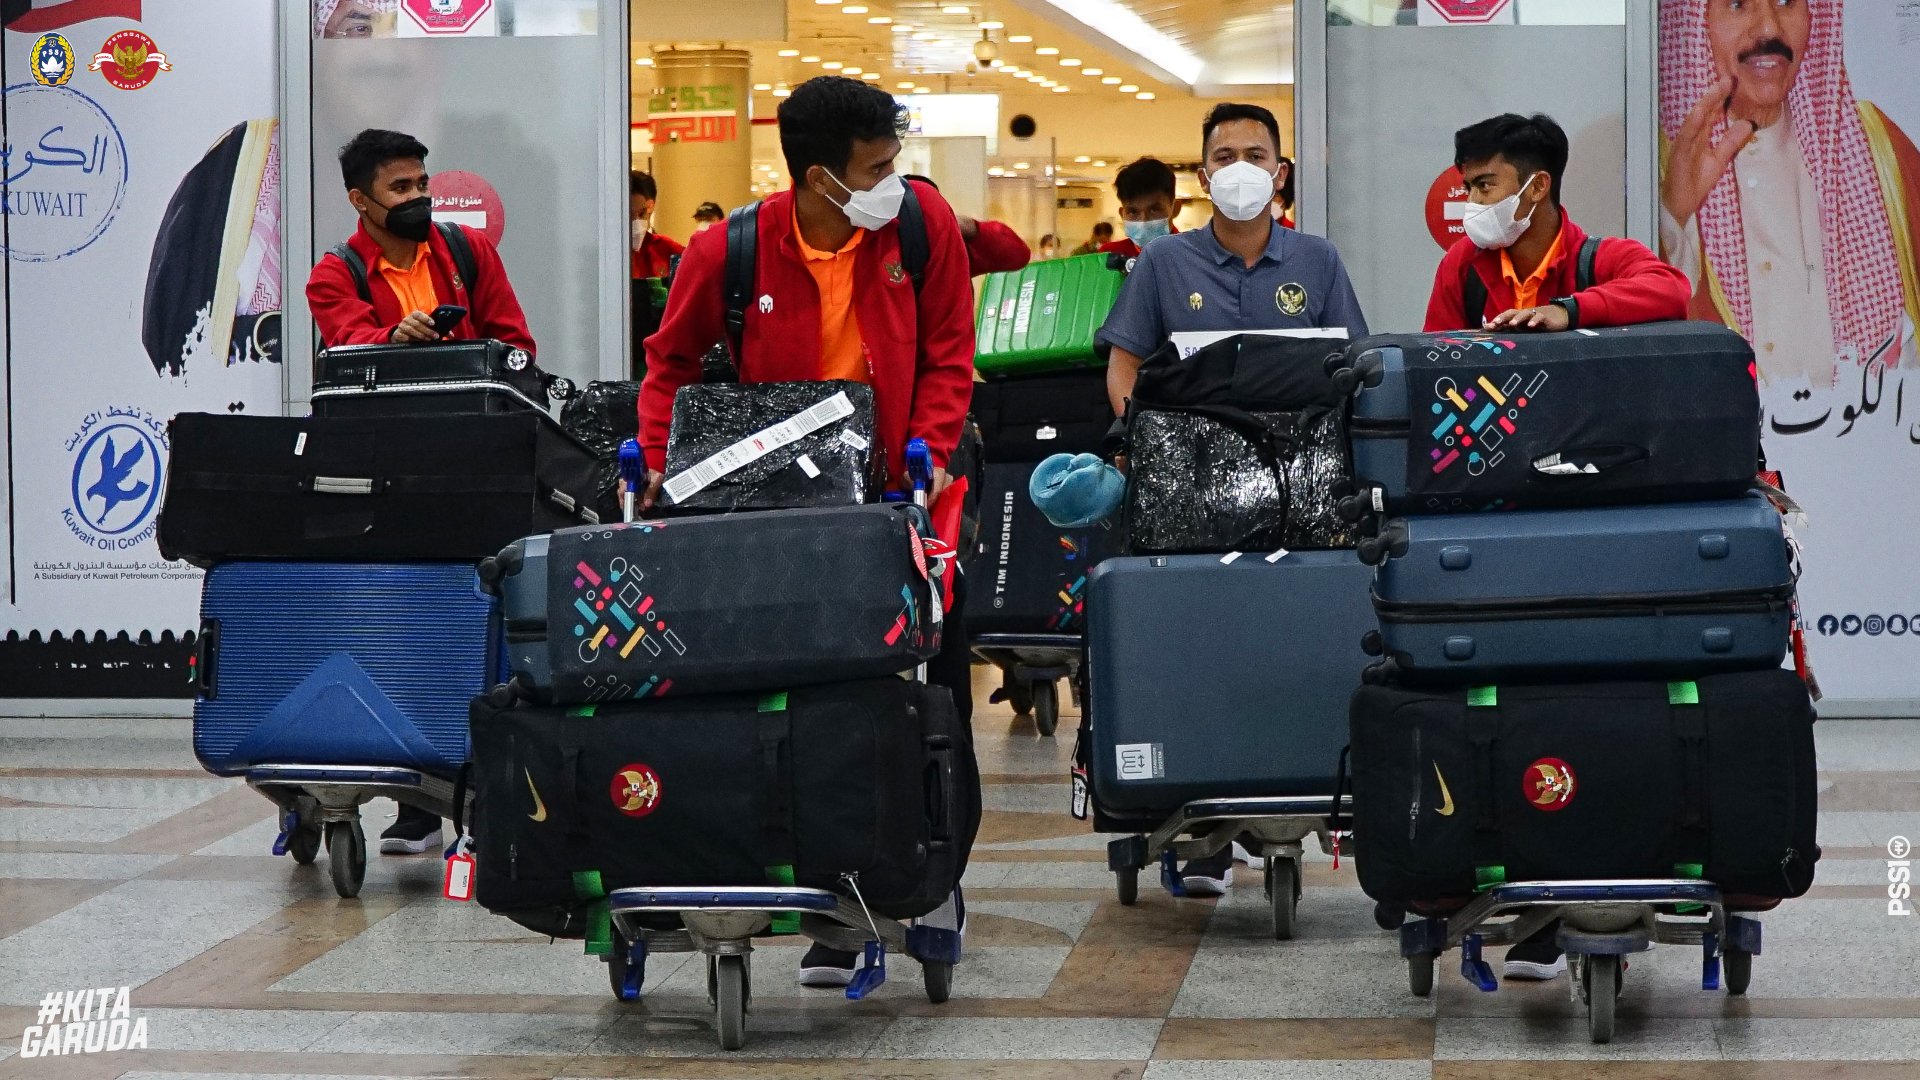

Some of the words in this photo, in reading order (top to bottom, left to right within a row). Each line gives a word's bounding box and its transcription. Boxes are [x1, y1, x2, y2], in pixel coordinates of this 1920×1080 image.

[0, 190, 88, 218] KUWAIT
[1448, 225, 1465, 233] NO
[1014, 280, 1036, 333] INDONESIA
[106, 405, 141, 419] نفط
[64, 410, 102, 452] الكويت
[61, 507, 95, 546] Kuwait
[97, 539, 115, 551] Oil
[117, 520, 157, 550] Compa
[1000, 491, 1014, 566] INDONESIA
[33, 561, 72, 571] الكويتية
[34, 572, 40, 580] A
[42, 572, 81, 581] Subsidiary
[83, 572, 91, 580] of
[92, 572, 119, 580] Kuwait
[120, 572, 159, 580] Petroleum
[996, 569, 1007, 594] TIM
